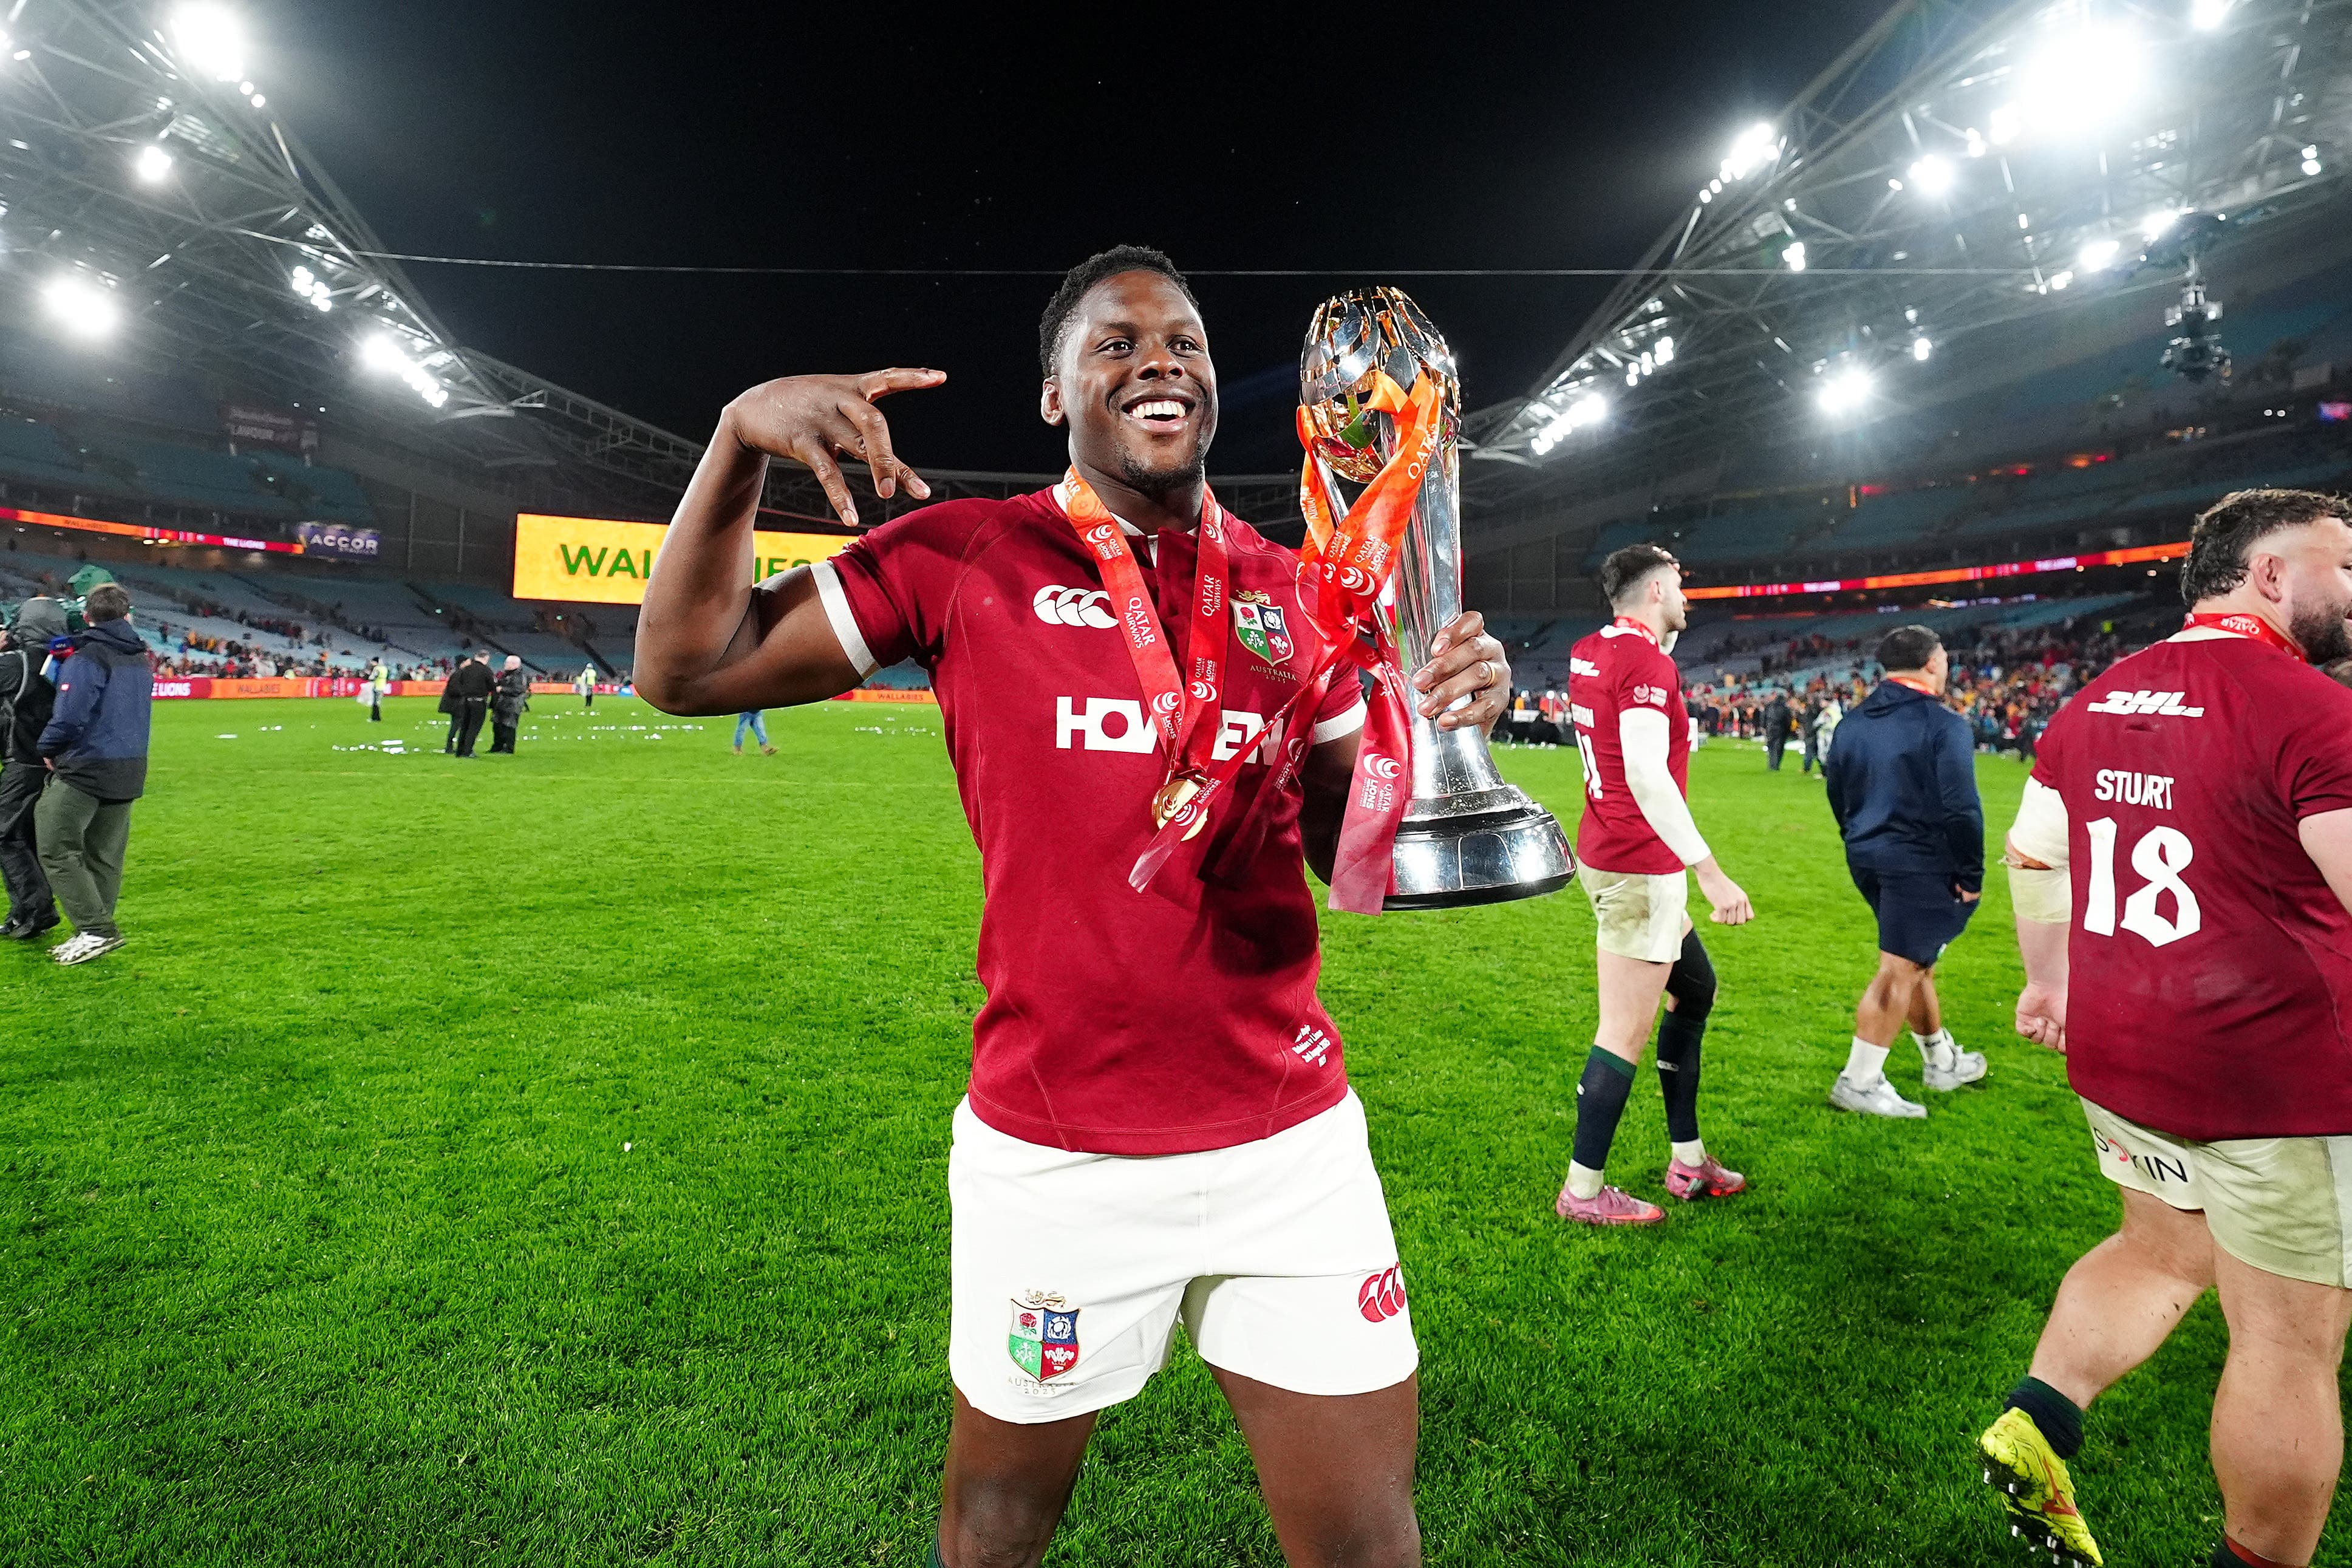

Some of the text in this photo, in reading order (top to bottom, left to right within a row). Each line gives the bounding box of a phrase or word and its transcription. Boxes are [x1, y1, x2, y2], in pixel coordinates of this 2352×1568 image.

[1064, 471, 1081, 497] ATAR
[310, 534, 378, 550] ACCOR
[1100, 542, 1113, 560] LIONS
[1109, 538, 1123, 556] QATAR
[1337, 535, 1352, 562] ONS
[1354, 534, 1377, 563] QATAR
[1368, 541, 1389, 570] LIONS
[561, 544, 812, 584] WALIE
[1201, 574, 1215, 617] QATAR
[1213, 578, 1222, 611] AIRWAYS
[1124, 612, 1144, 649] AIRWAYS
[1129, 596, 1156, 646] QATAR
[1205, 660, 1213, 681] LIONS
[1250, 665, 1297, 681] AUSTRALIA
[158, 683, 191, 697] LIONS
[2100, 690, 2190, 715] DHL
[1056, 696, 1283, 766] HOEN
[1165, 715, 1177, 739] LIONS
[1366, 779, 1379, 810] LIONS
[1381, 783, 1394, 813] QATAR
[2095, 768, 2175, 810] STUART
[2083, 817, 2201, 947] 18
[2093, 1127, 2189, 1182] SIN
[1007, 1375, 1076, 1389] AUSTR
